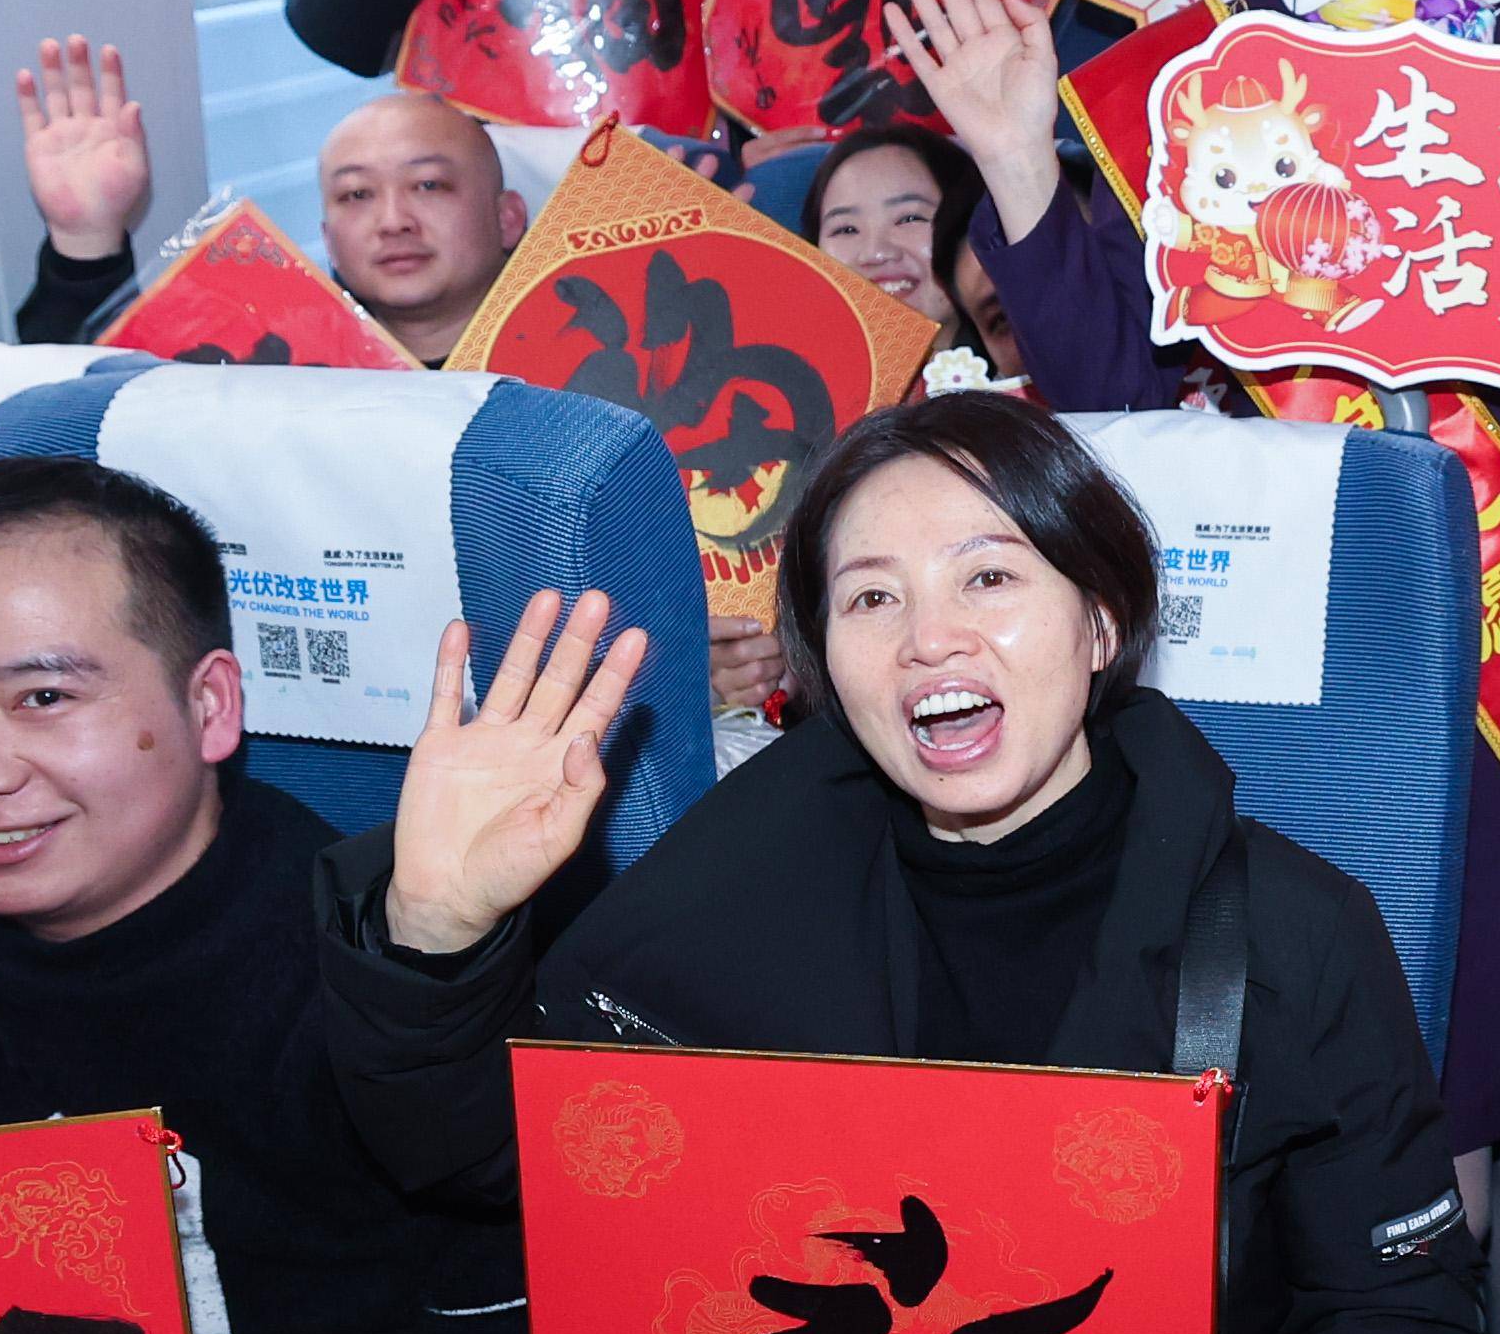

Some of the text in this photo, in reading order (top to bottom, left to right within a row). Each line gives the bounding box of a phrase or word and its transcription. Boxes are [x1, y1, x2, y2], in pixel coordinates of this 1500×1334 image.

[1162, 547, 1231, 573] 变世界
[229, 569, 369, 605] 光伏改变世界
[1187, 577, 1228, 588] WORLD
[249, 601, 300, 617] CHANGES
[303, 608, 325, 619] THE
[327, 610, 370, 621] WORLD
[1386, 1223, 1408, 1238] FIND
[1408, 1212, 1431, 1230] EACH
